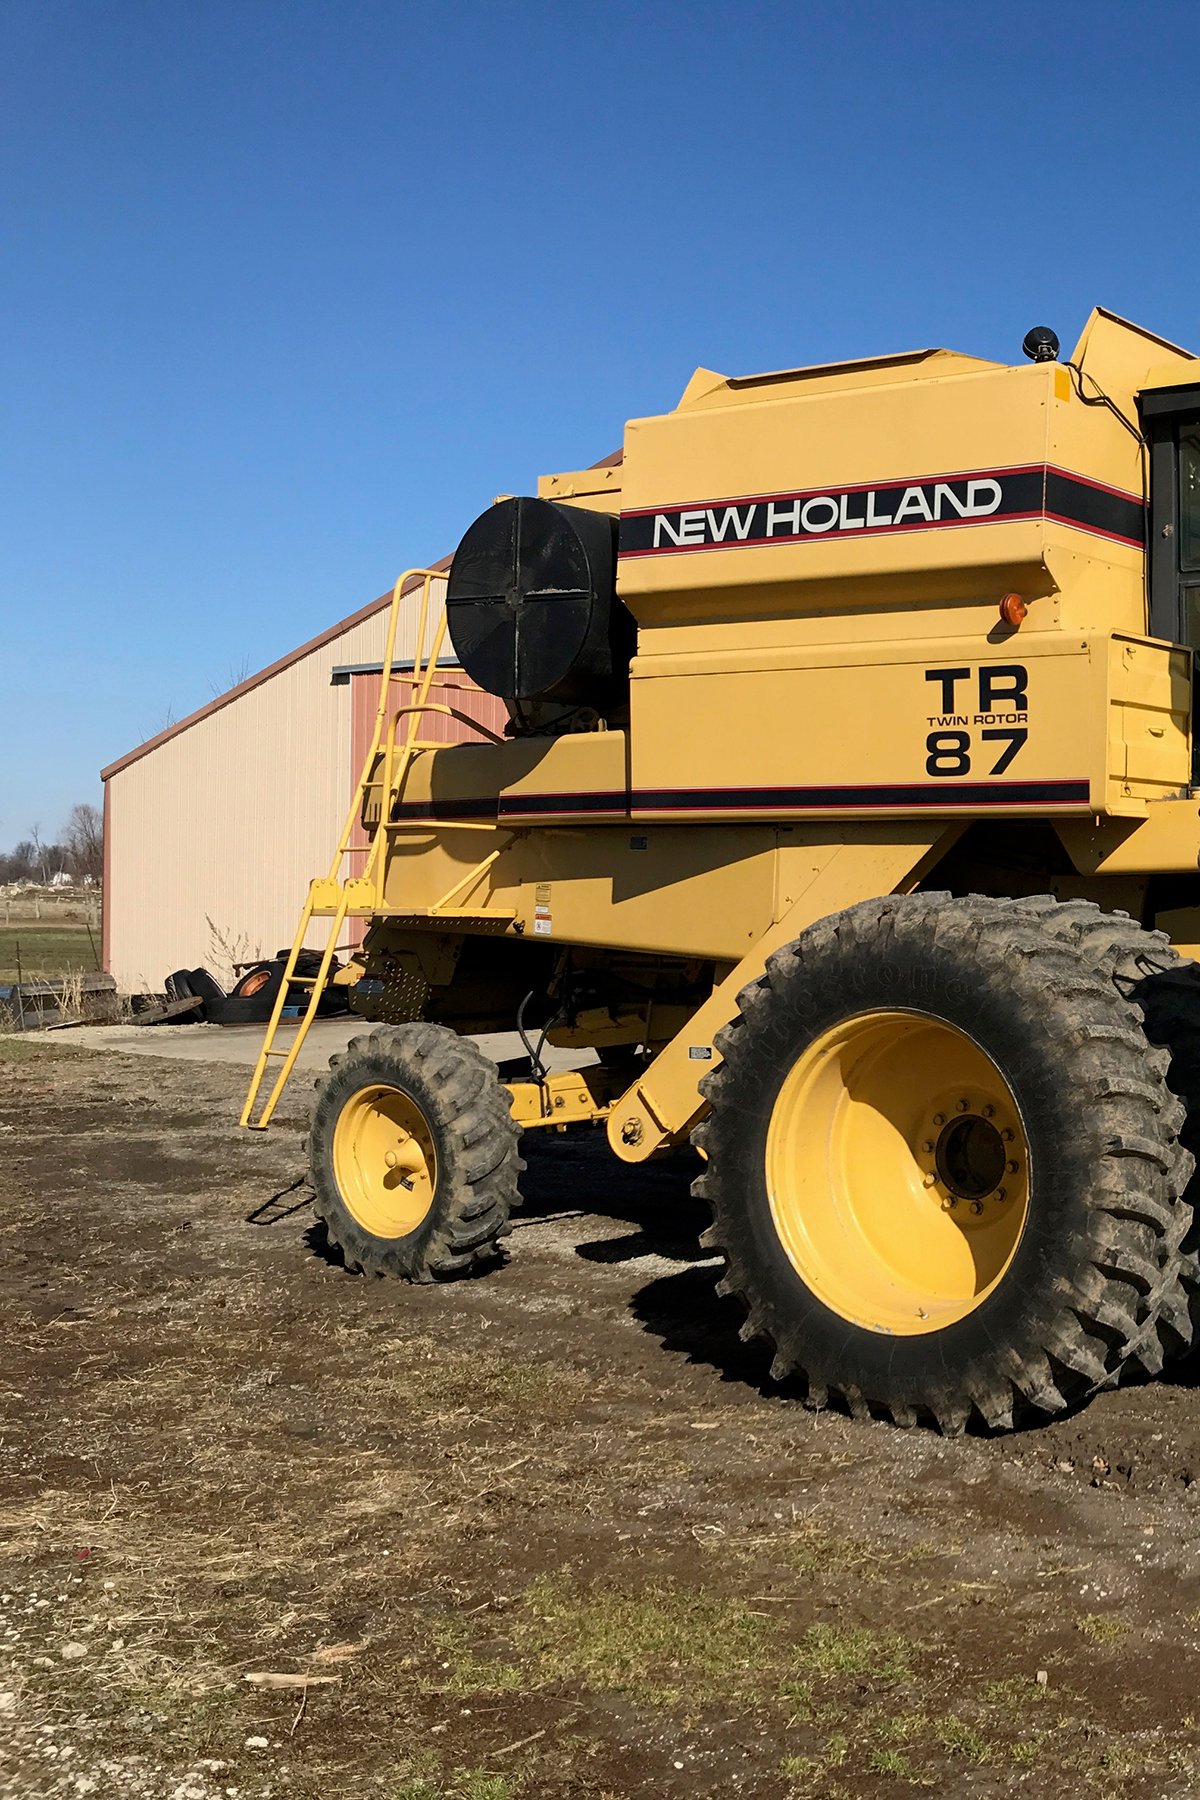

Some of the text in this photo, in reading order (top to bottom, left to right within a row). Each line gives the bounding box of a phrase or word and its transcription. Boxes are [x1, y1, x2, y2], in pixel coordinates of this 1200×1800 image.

[653, 478, 1002, 548] NEW HOLLAND
[925, 665, 1028, 714] TR
[927, 713, 1028, 727] TWIN ROTOR
[926, 728, 1028, 777] 87
